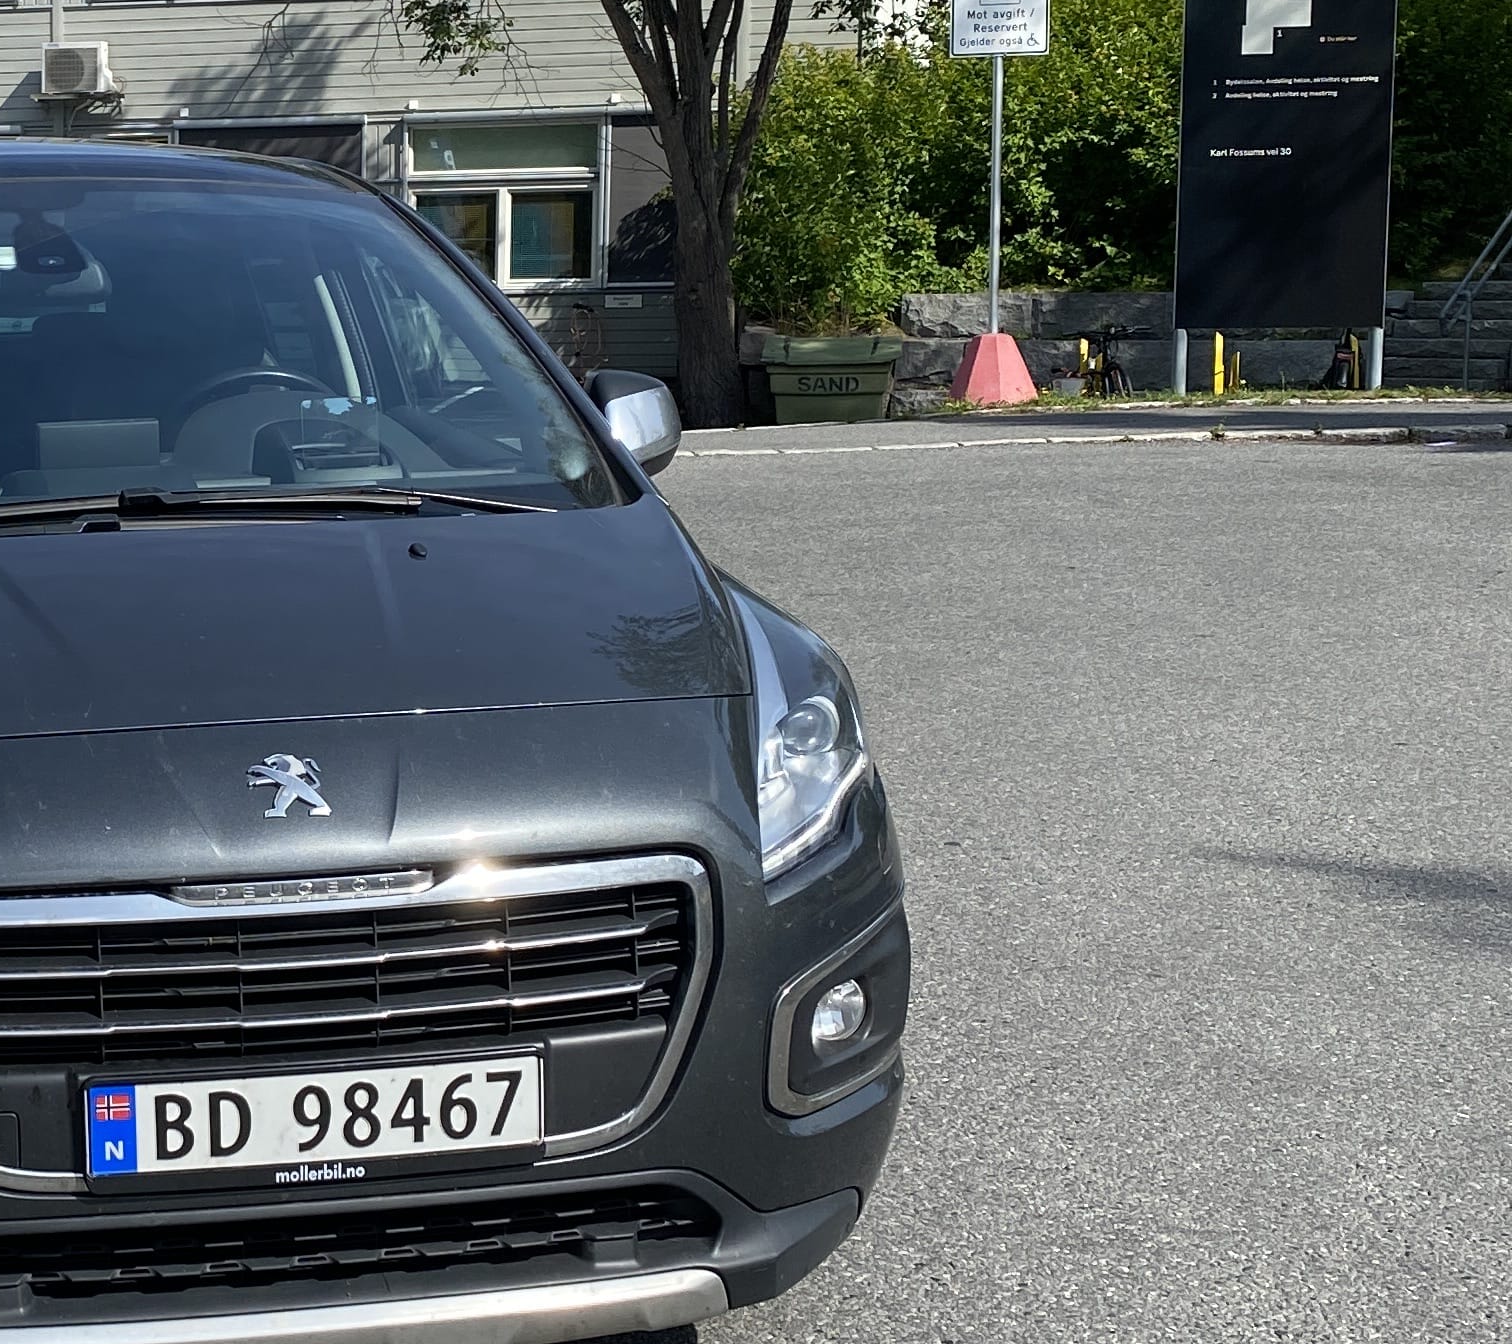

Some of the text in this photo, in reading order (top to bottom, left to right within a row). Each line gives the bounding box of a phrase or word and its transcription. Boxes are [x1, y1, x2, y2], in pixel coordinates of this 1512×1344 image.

[967, 9, 988, 20] Mot
[992, 7, 1026, 21] avgift
[973, 22, 1028, 33] Reservert
[1277, 29, 1283, 37] 1
[959, 36, 1023, 48] Gjelder også
[1210, 149, 1228, 157] Karl
[1266, 147, 1279, 156] vei
[1280, 147, 1292, 156] 30
[798, 376, 860, 392] SAND
[214, 875, 395, 900] PEUGEOT
[104, 1070, 524, 1161] N BD 98467
[275, 1164, 366, 1184] mollerbil.no
